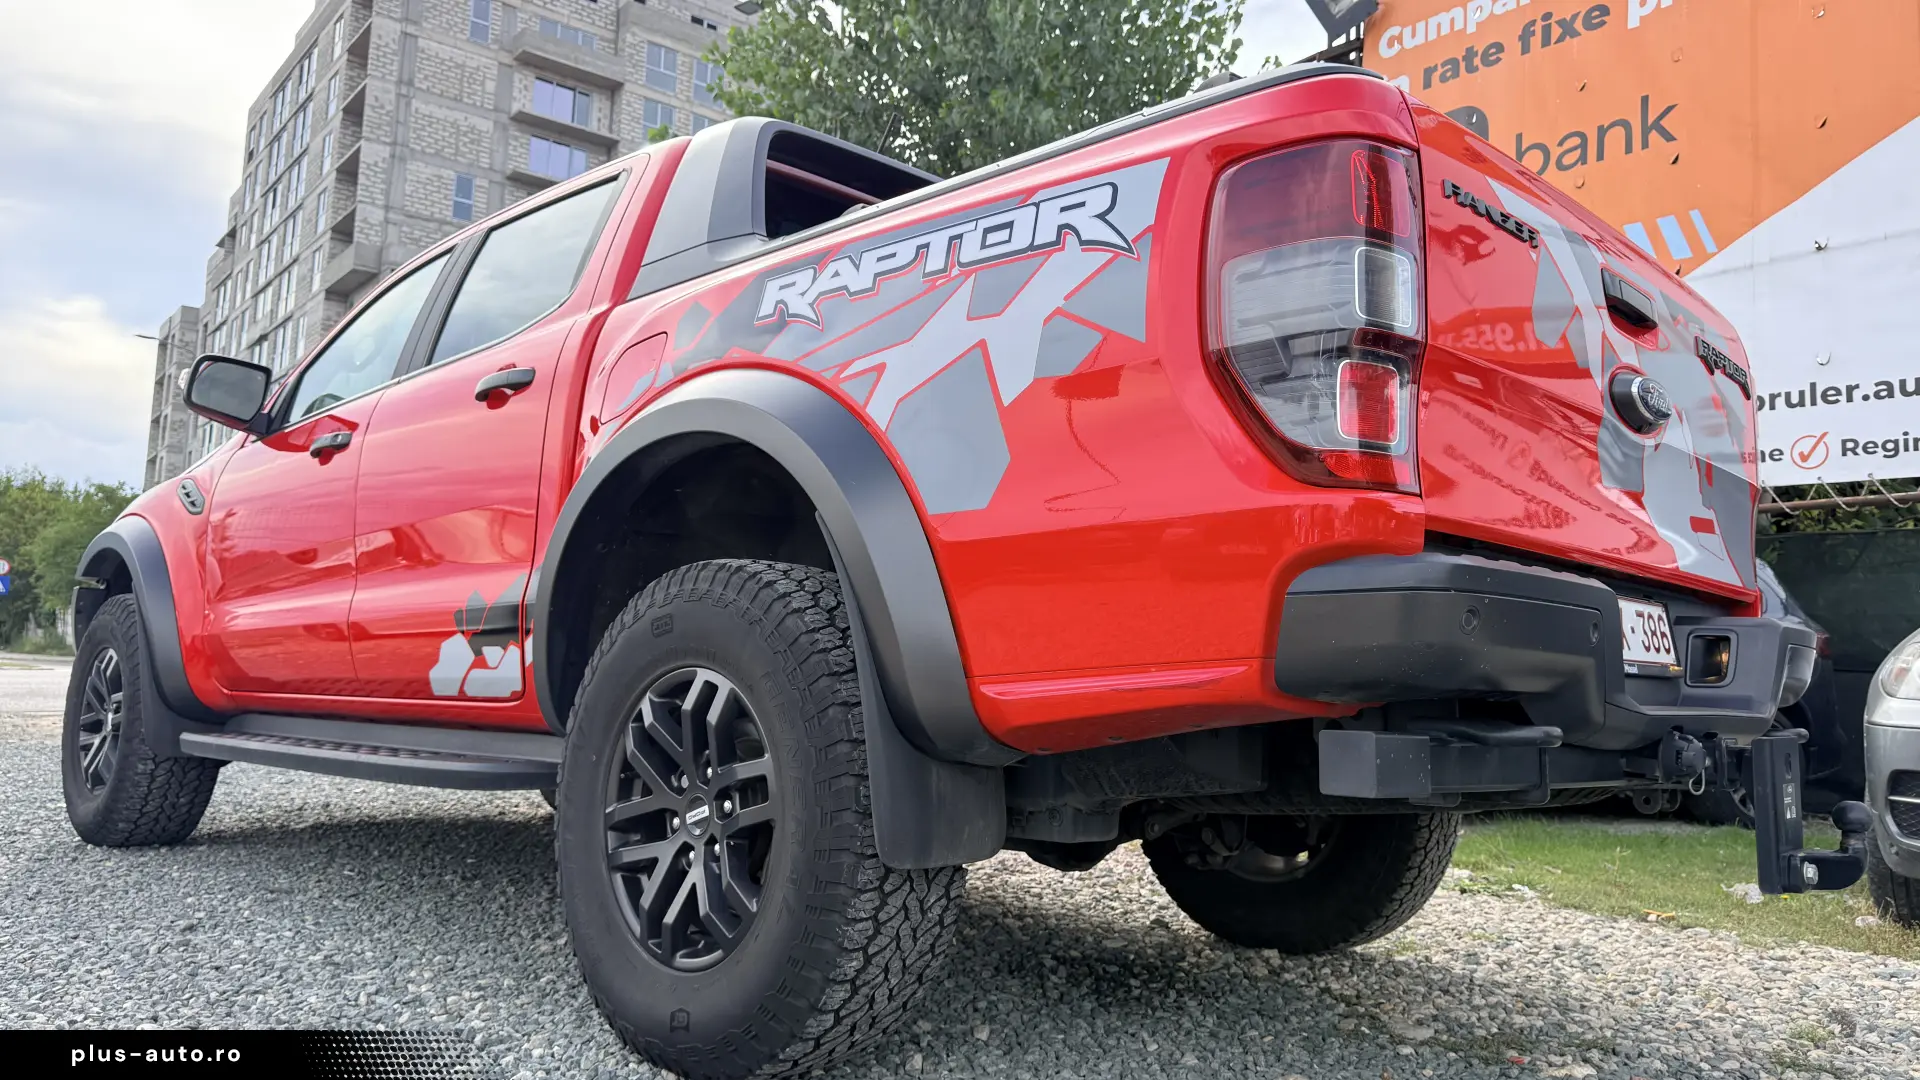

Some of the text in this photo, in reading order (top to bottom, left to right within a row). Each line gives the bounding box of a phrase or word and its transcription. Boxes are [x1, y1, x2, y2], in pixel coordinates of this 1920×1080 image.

[1378, 0, 1673, 59] Cumpa p
[1422, 41, 1505, 90] rate
[1518, 4, 1611, 56] fixe
[1515, 94, 1679, 177] bank
[1442, 178, 1539, 249] RANGER
[754, 182, 1141, 331] RAPTOR
[1648, 382, 1671, 414] Ford
[1695, 336, 1751, 401] RAPTOR
[1760, 447, 1785, 463] e
